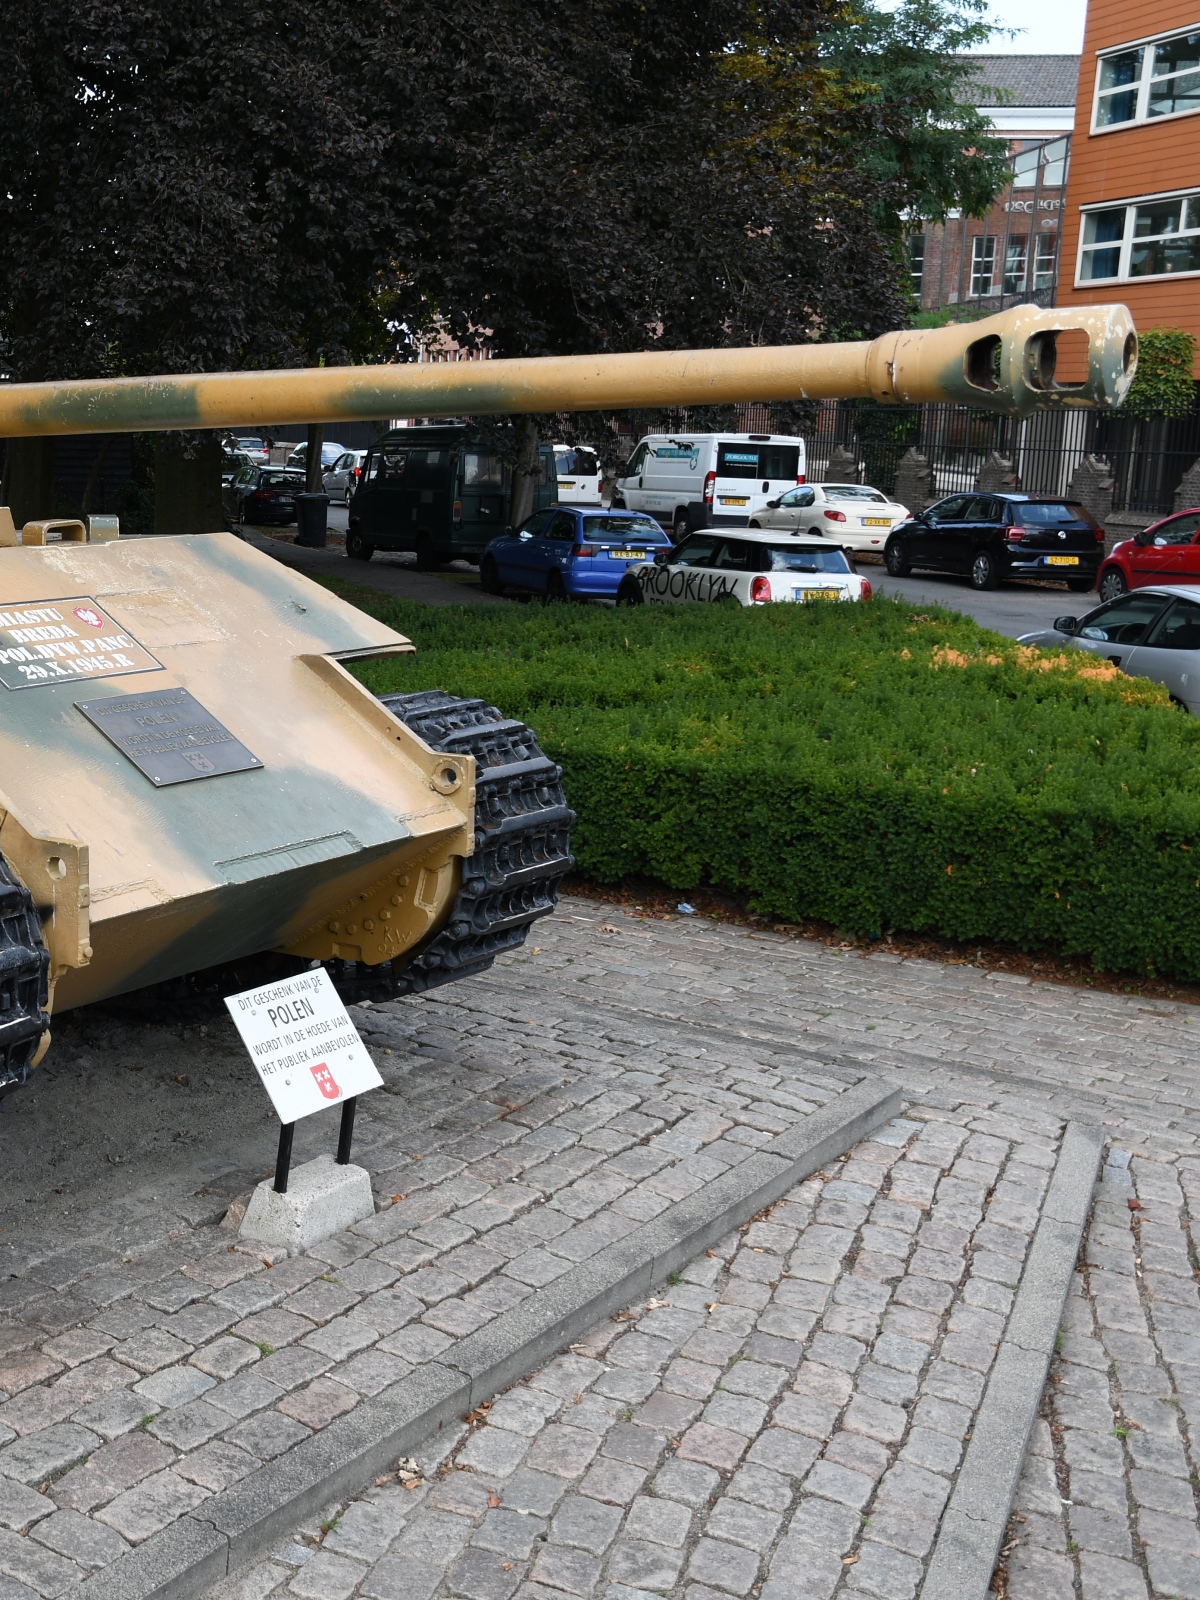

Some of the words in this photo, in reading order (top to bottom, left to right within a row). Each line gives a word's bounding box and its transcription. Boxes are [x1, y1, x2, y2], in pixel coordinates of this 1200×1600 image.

[637, 566, 739, 603] BROOKLYN
[7, 624, 80, 643] BREDA
[96, 705, 111, 716] DIT
[111, 700, 156, 713] GESCHENK
[156, 697, 176, 707] VAN
[174, 696, 187, 704] DE
[135, 713, 178, 727] POLEN
[119, 734, 153, 746] WORDT
[152, 732, 162, 741] IN
[160, 730, 176, 740] DE
[175, 726, 203, 738] HOEDE
[201, 723, 220, 733] VAN
[127, 747, 147, 757] HET
[145, 740, 182, 755] PUBLIEK
[238, 997, 252, 1011] DIT
[253, 984, 295, 1006] GESCHENK
[293, 978, 311, 995] VAN
[311, 976, 323, 989] DE
[267, 997, 315, 1028] POLEN
[252, 1037, 283, 1056] WORDT
[283, 1034, 294, 1046] IN
[294, 1030, 307, 1043] DE
[306, 1021, 333, 1039] HOEDE
[331, 1015, 349, 1031] VAN
[260, 1061, 277, 1076] HET
[278, 1050, 311, 1070] PUBLIEK
[311, 1033, 360, 1060] AANBEVOLEN
